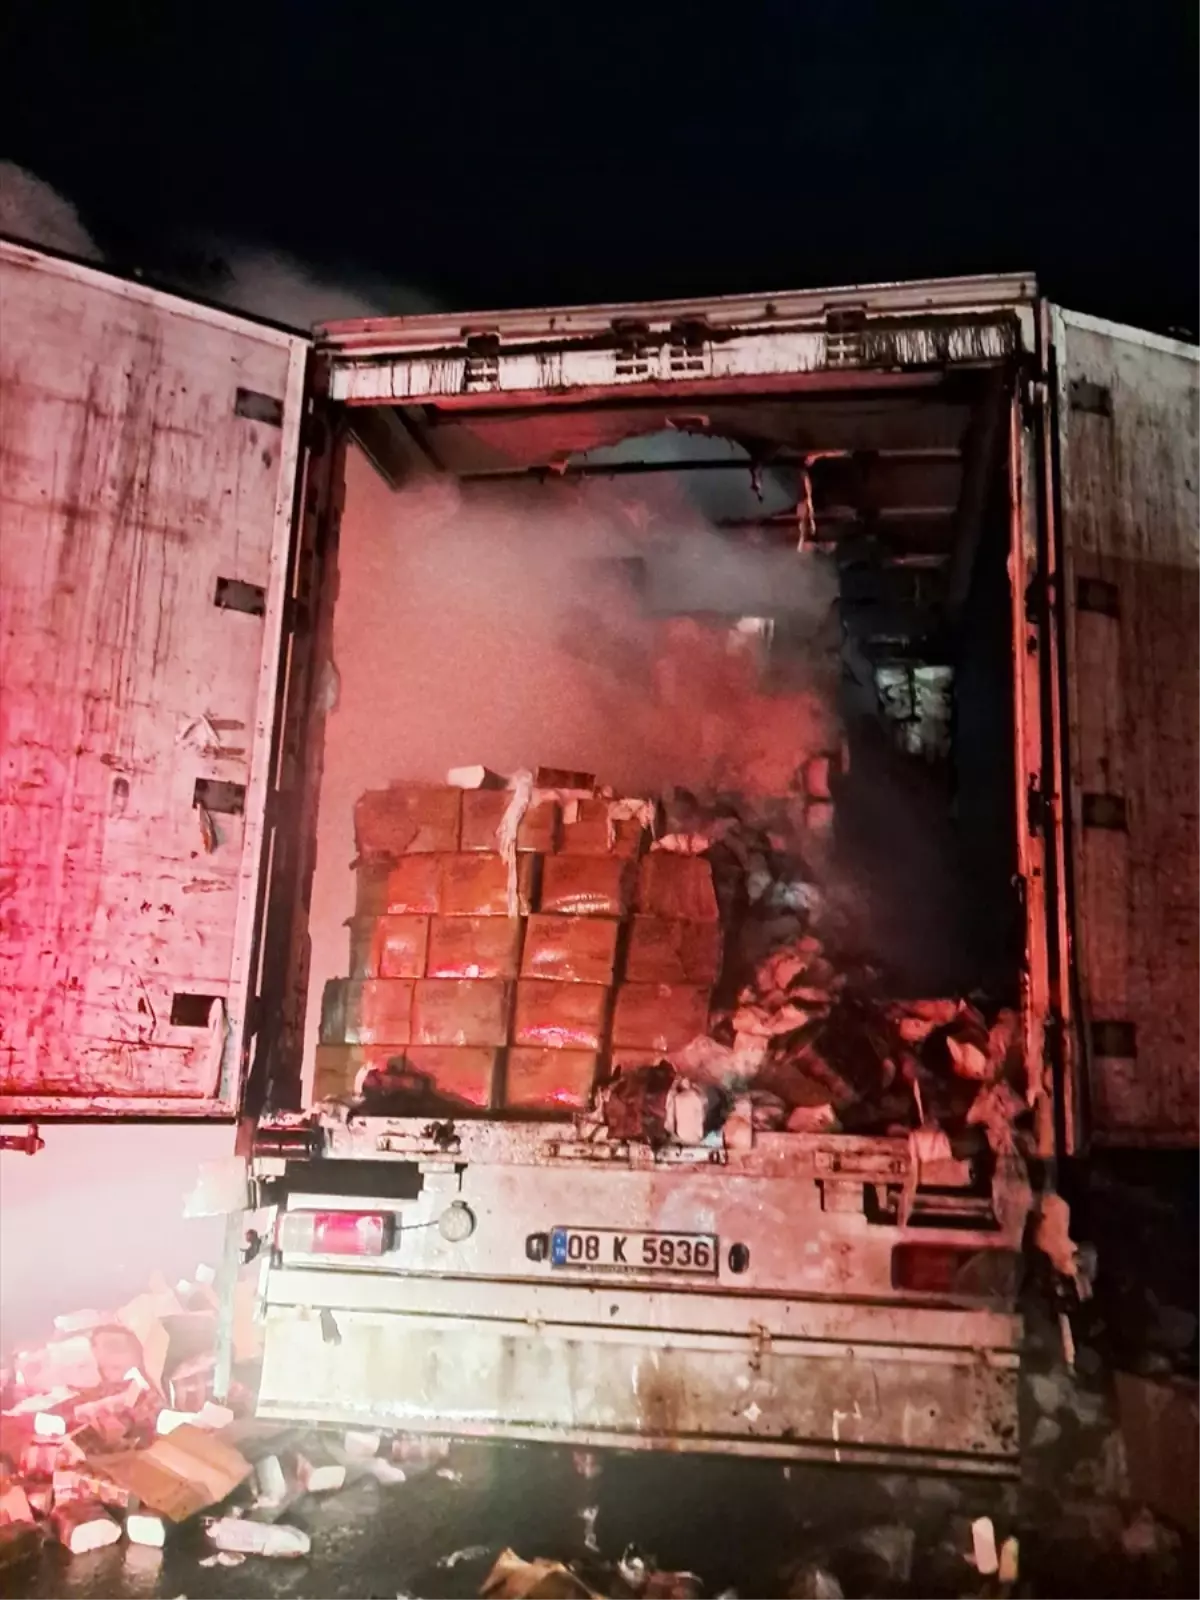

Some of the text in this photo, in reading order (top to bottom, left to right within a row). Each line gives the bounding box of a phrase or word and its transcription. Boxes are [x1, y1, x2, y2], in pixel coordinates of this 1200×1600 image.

[567, 1234, 710, 1267] 08 K 5936
